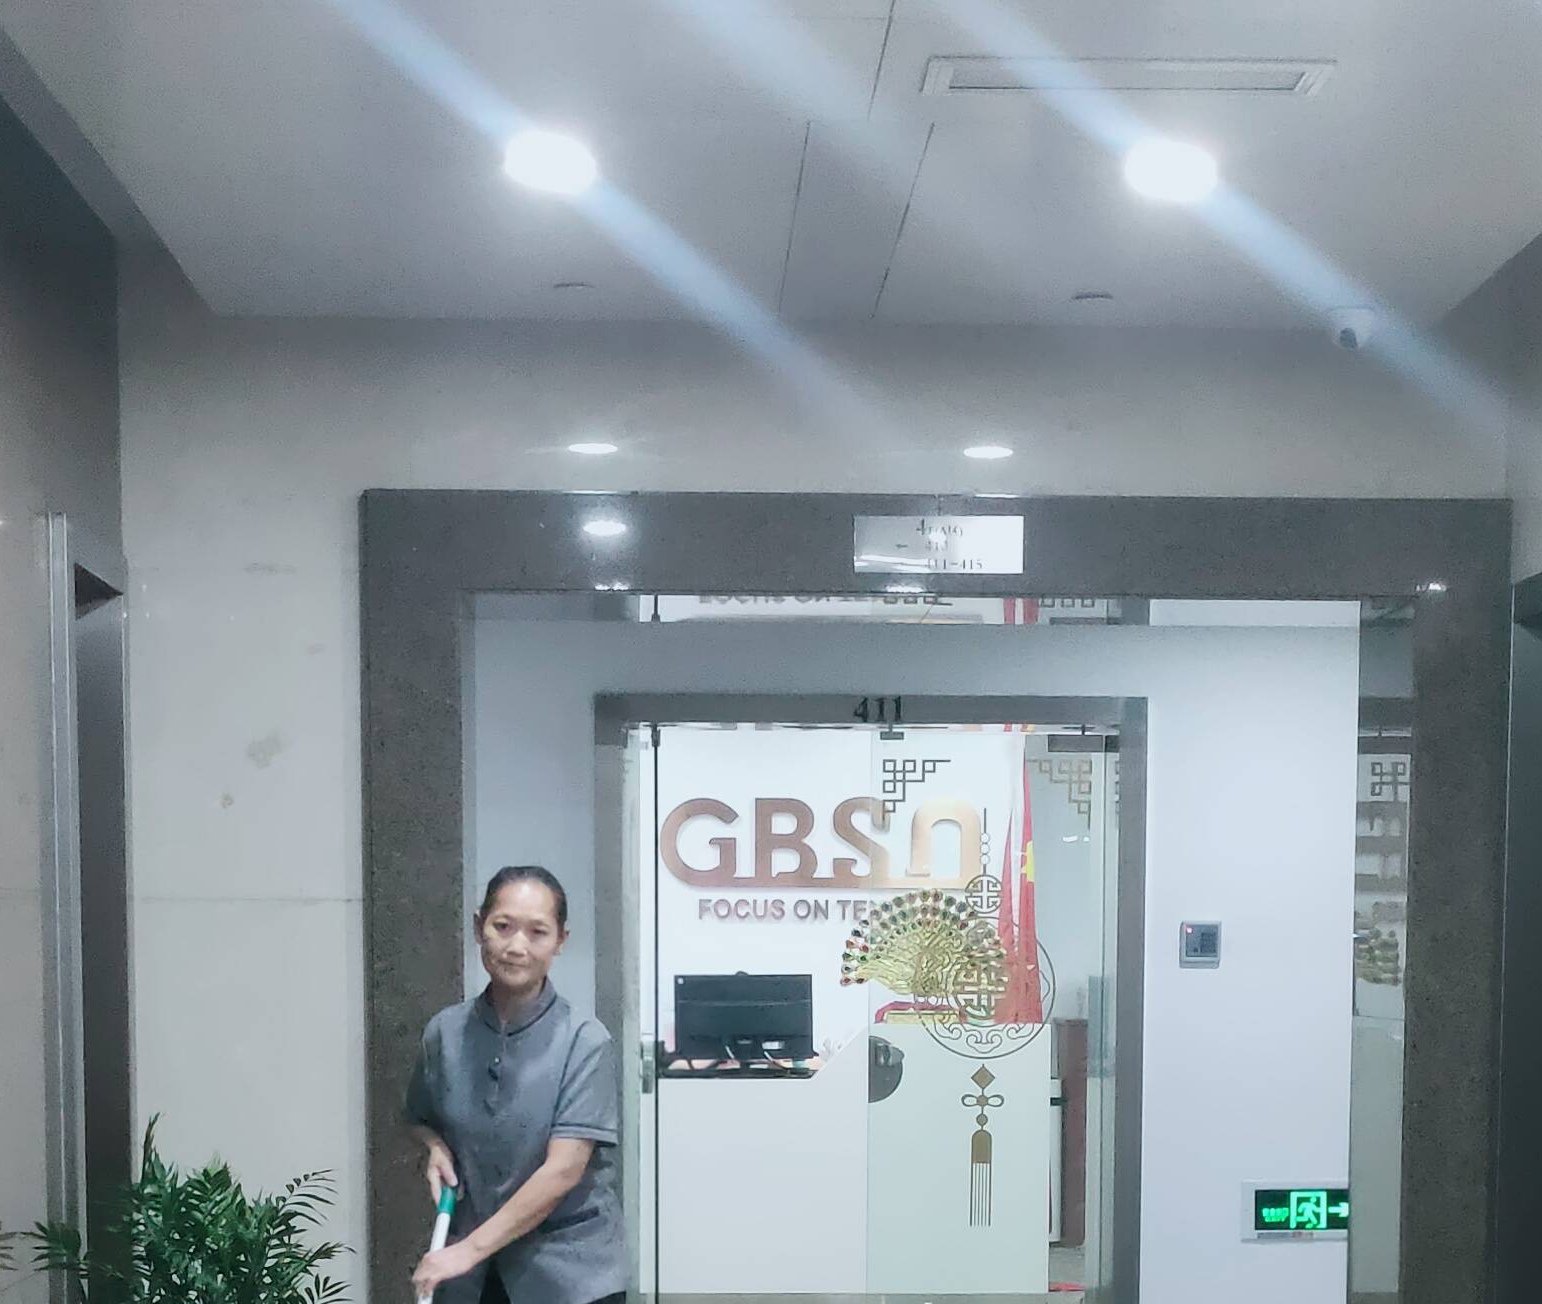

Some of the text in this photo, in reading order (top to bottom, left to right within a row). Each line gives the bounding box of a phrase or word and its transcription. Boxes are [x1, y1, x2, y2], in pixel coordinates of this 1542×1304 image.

[853, 696, 902, 723] 411
[698, 898, 786, 921] FOCUS
[793, 899, 829, 921] ON
